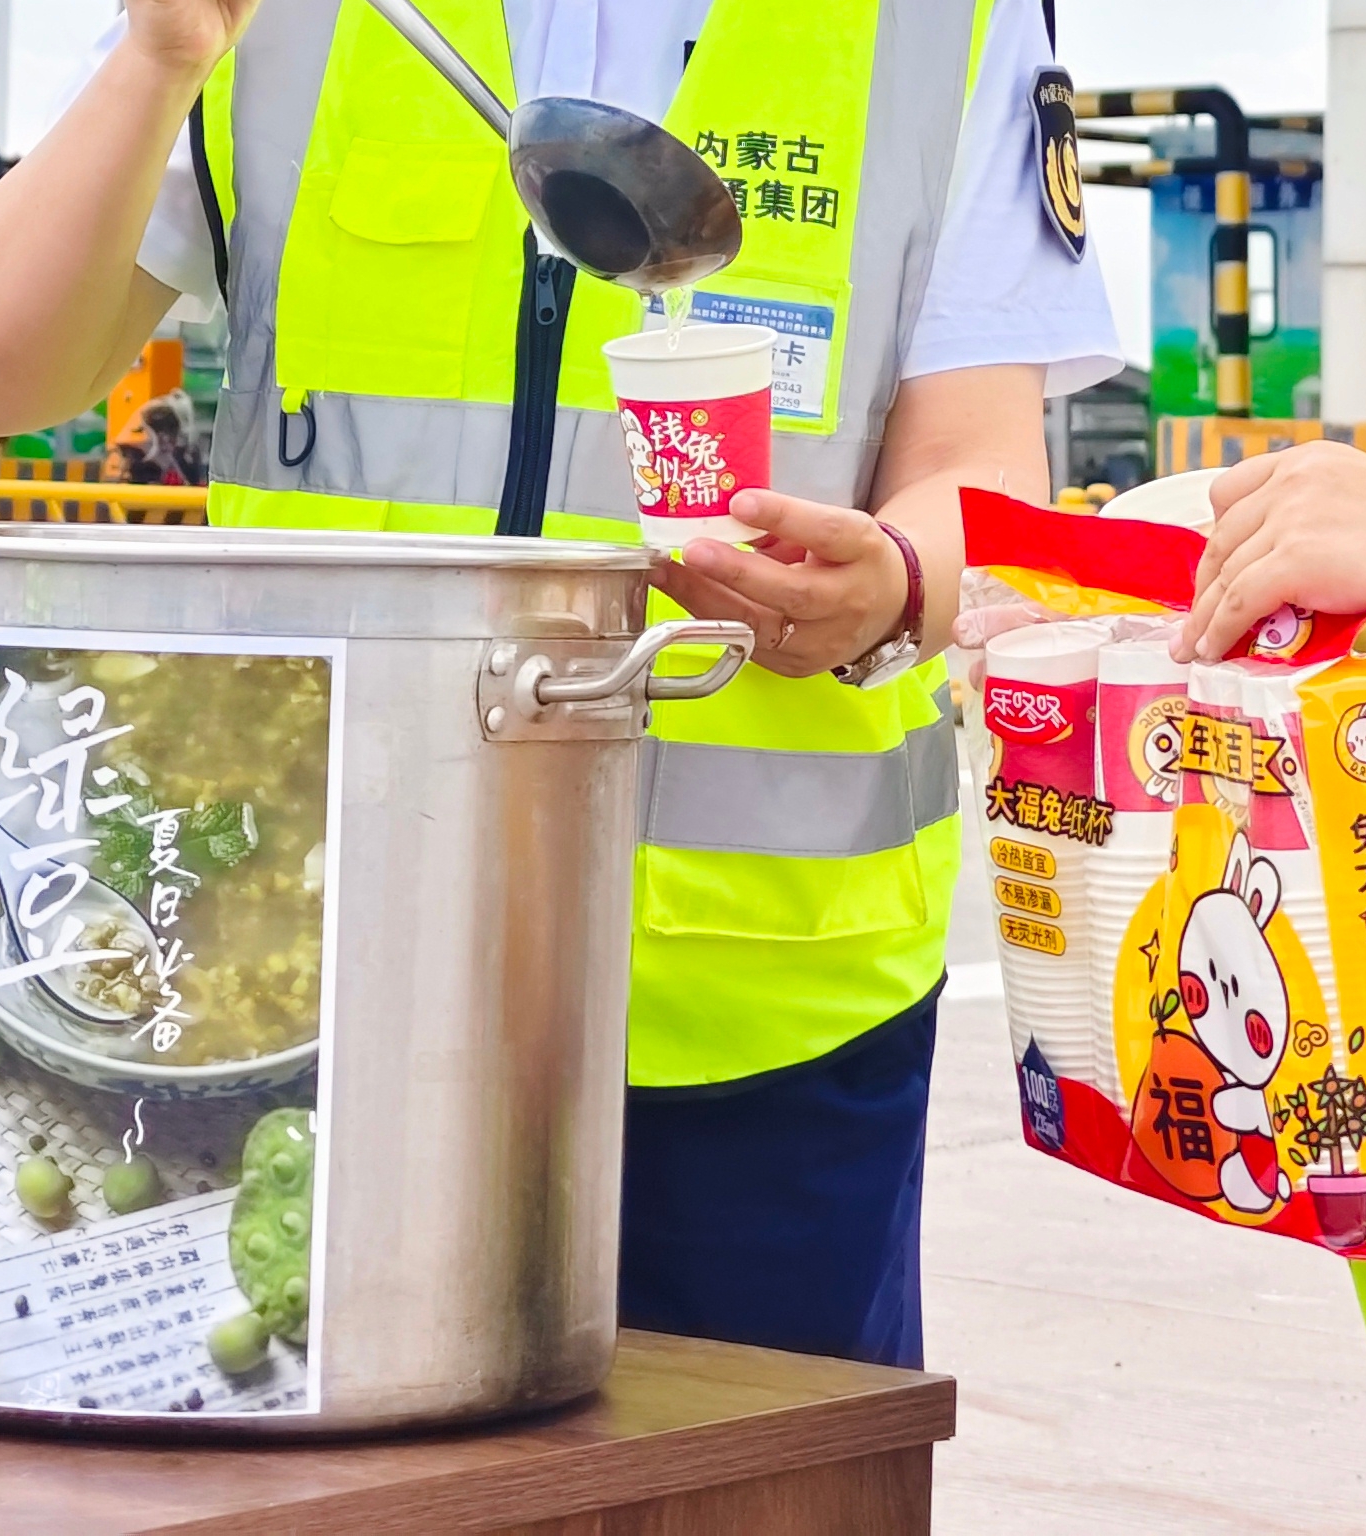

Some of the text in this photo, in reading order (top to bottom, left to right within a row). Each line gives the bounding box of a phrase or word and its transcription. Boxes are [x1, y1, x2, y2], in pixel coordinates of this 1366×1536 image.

[695, 129, 824, 174] 内蒙古
[772, 340, 805, 366] 卡
[986, 779, 1114, 846] 大福兔纸杯
[996, 843, 1048, 874] 冷热皆宜
[1001, 881, 1053, 914] 不易渗漏
[131, 808, 202, 1053] 夏日必备
[1005, 918, 1058, 951] 无荧光剂
[1022, 1066, 1050, 1109] 100
[1150, 1072, 1216, 1166] 福
